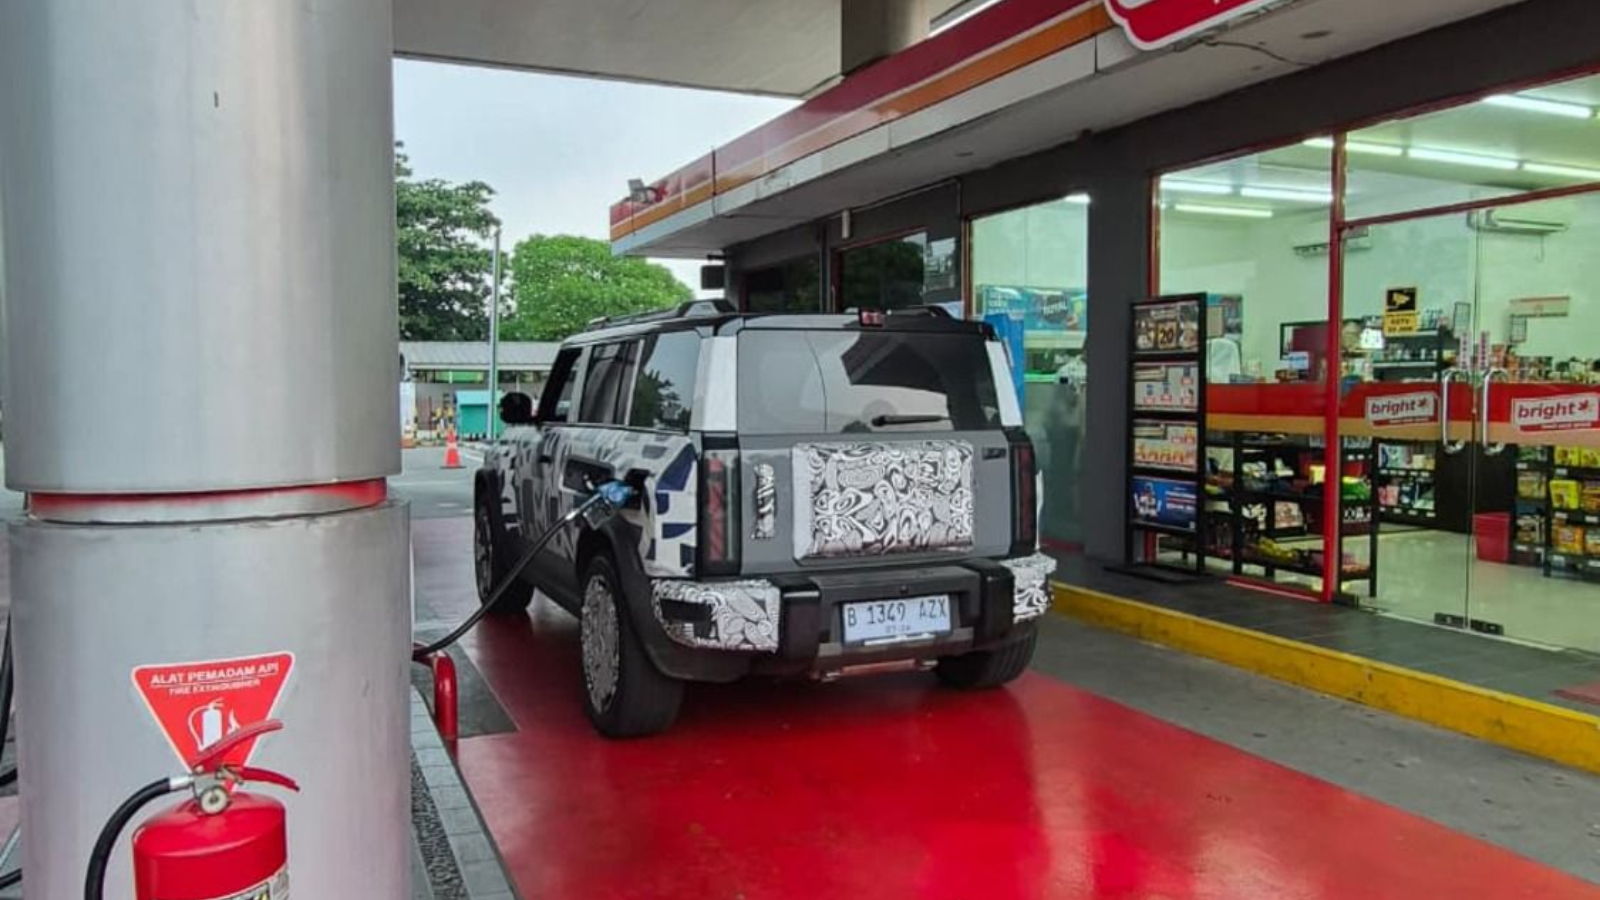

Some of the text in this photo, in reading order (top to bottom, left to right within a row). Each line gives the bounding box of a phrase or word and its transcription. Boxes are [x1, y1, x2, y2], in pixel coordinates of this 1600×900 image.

[1370, 400, 1416, 416] bright
[1518, 401, 1575, 420] bright
[847, 598, 947, 627] B 1349 AZX
[151, 662, 279, 684] ALAT PEMADAM API
[169, 679, 260, 695] FIRE EXTINGUISHER
